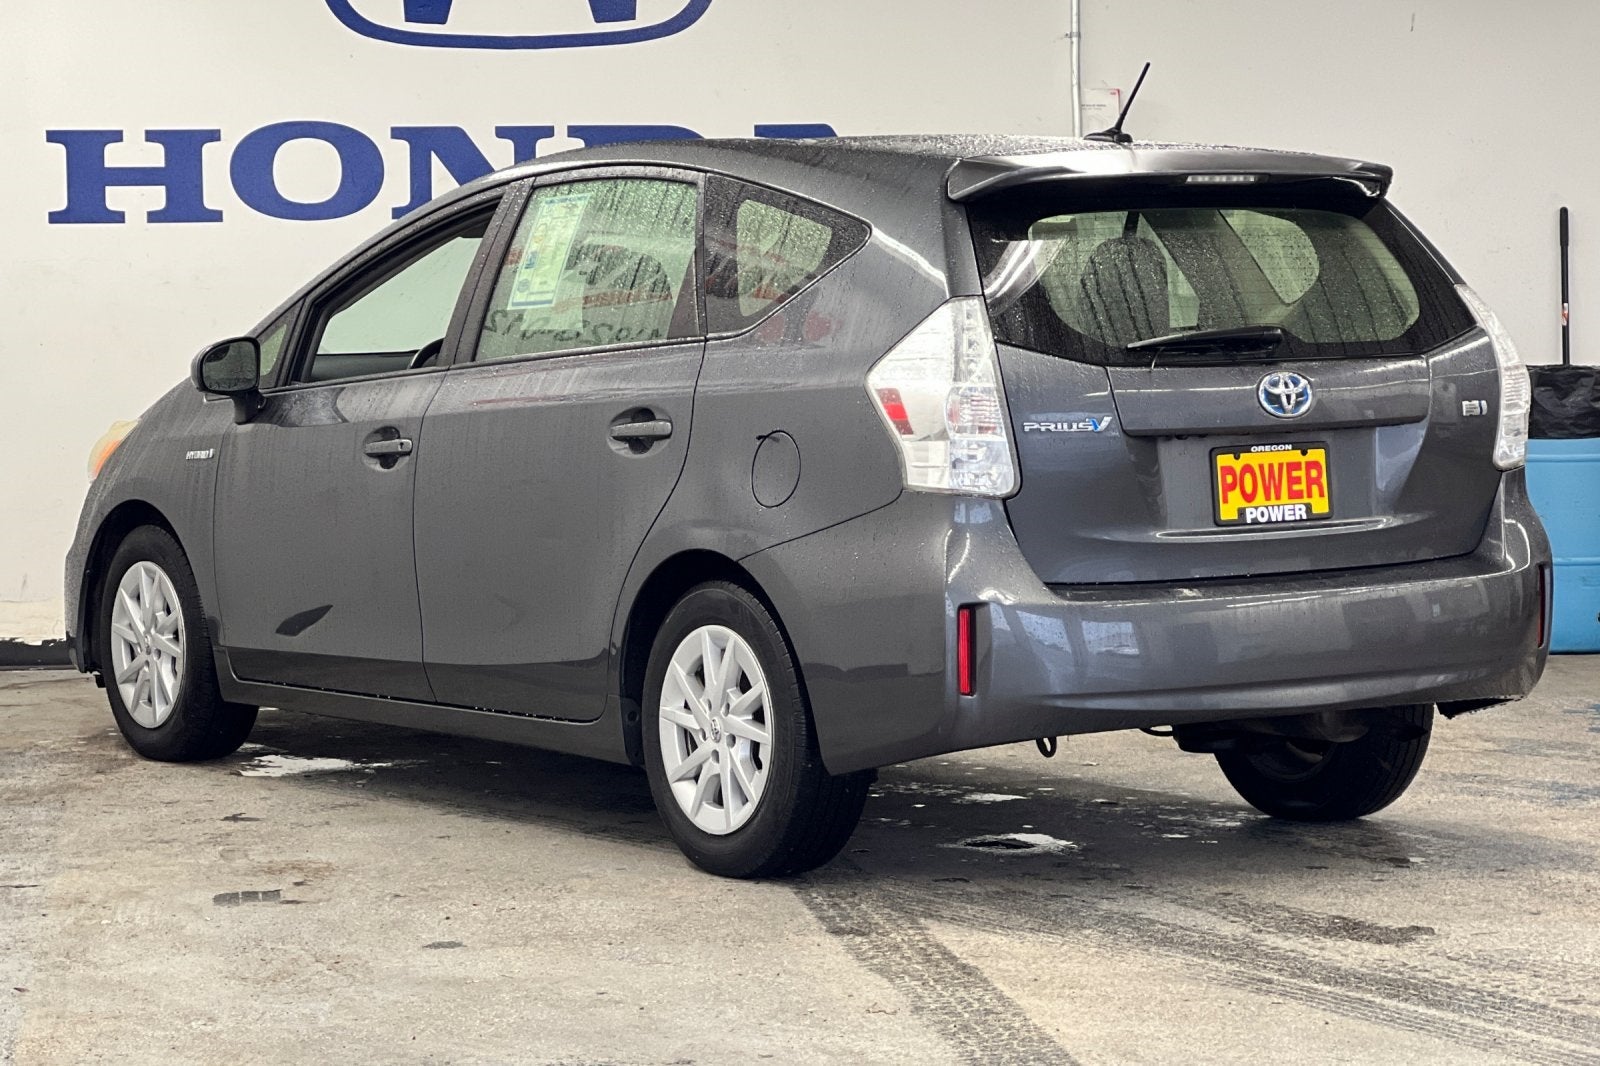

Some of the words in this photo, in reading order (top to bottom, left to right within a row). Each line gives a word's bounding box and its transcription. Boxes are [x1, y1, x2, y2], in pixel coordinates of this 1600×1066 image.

[46, 121, 836, 223] HON
[1250, 444, 1292, 452] OREGON
[1220, 460, 1325, 504] POWER
[1245, 503, 1307, 524] POWER
